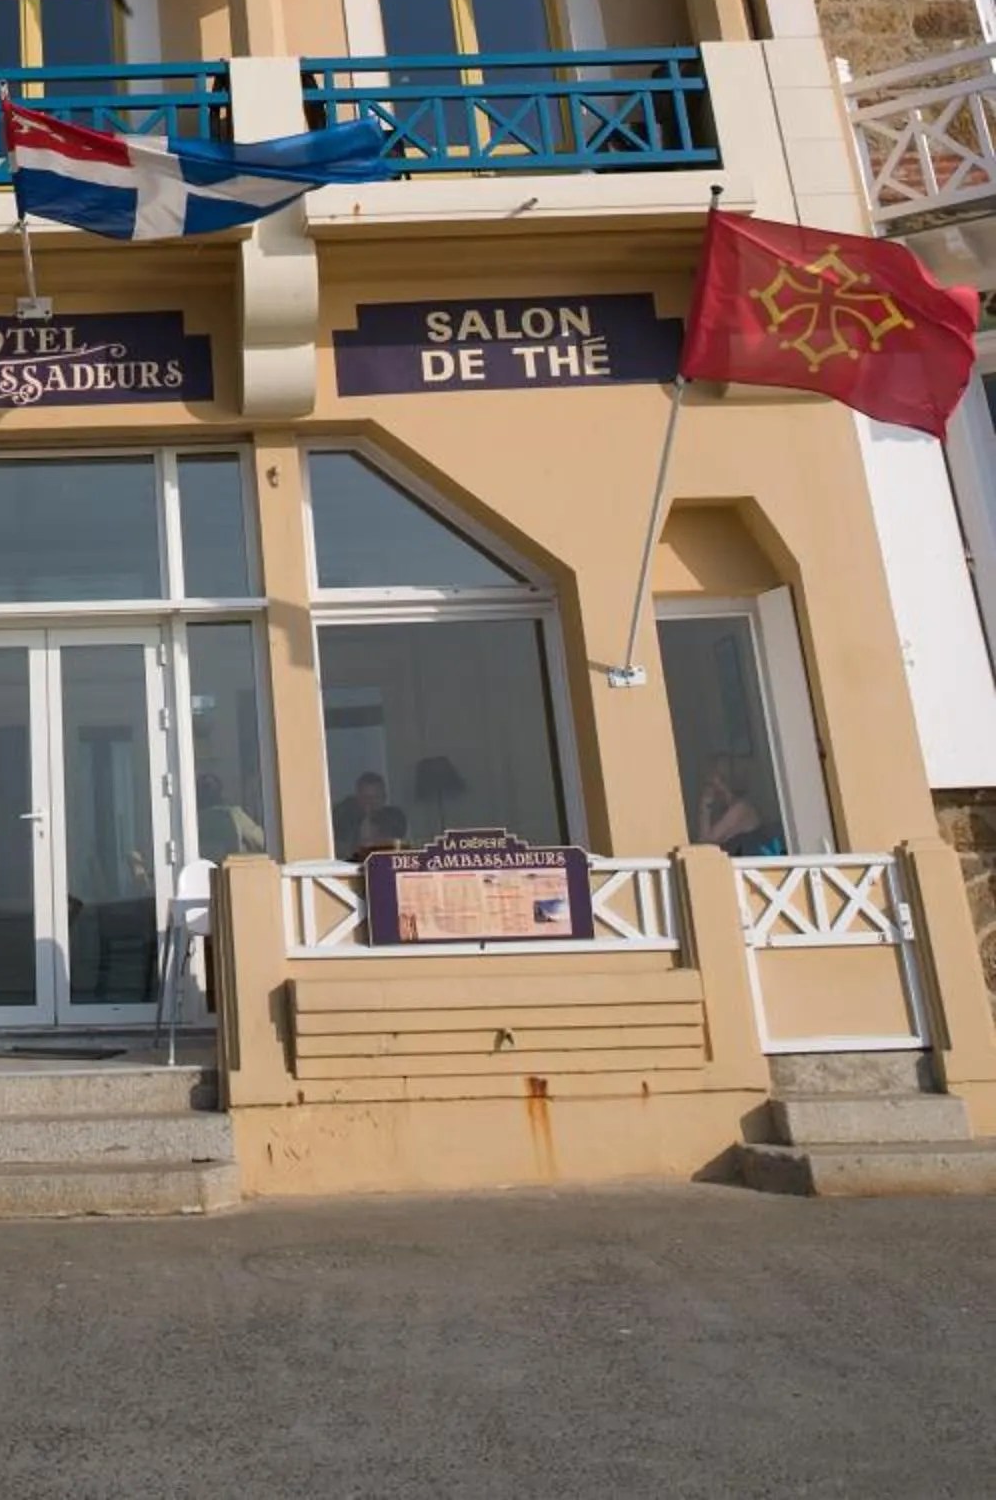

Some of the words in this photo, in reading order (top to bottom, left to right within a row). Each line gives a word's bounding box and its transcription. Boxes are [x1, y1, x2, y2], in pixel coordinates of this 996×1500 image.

[426, 306, 591, 342] SALON
[421, 349, 486, 382] DE
[512, 336, 611, 378] THÉ
[391, 855, 420, 870] DES
[427, 852, 566, 870] AMBASSADEURS
